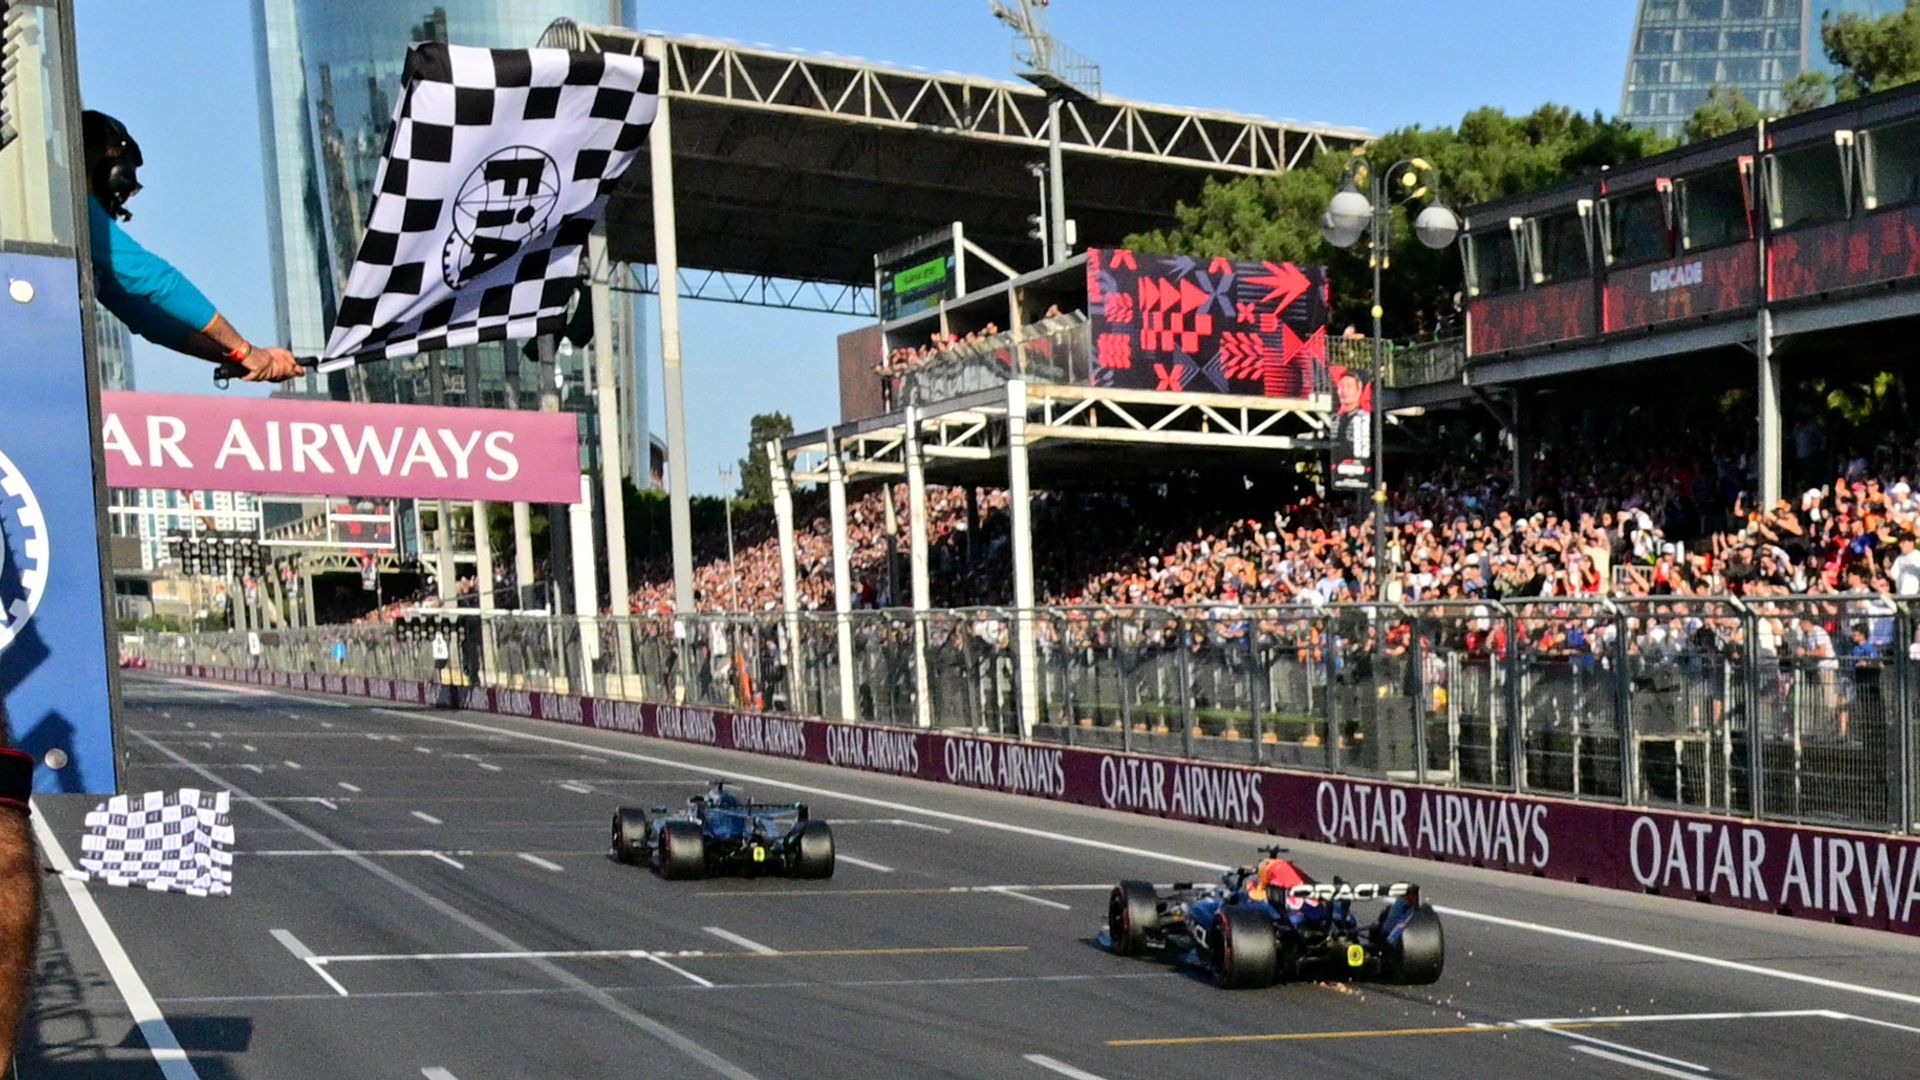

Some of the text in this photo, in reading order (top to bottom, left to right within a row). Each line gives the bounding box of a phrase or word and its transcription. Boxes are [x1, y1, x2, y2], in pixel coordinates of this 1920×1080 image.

[1650, 261, 1703, 292] DECADE
[214, 418, 520, 482] AIRWAYS
[732, 714, 806, 757] QATAR AIRWAYS
[826, 725, 919, 774] QATAR AIRWAYS
[944, 738, 1065, 796] QATAR AIRWAYS
[1100, 755, 1264, 826] QATAR AIRWAYS
[1316, 780, 1550, 868] QATAR AIRWAYS
[1630, 816, 1768, 901] QATAR
[1289, 882, 1409, 900] ORACLE
